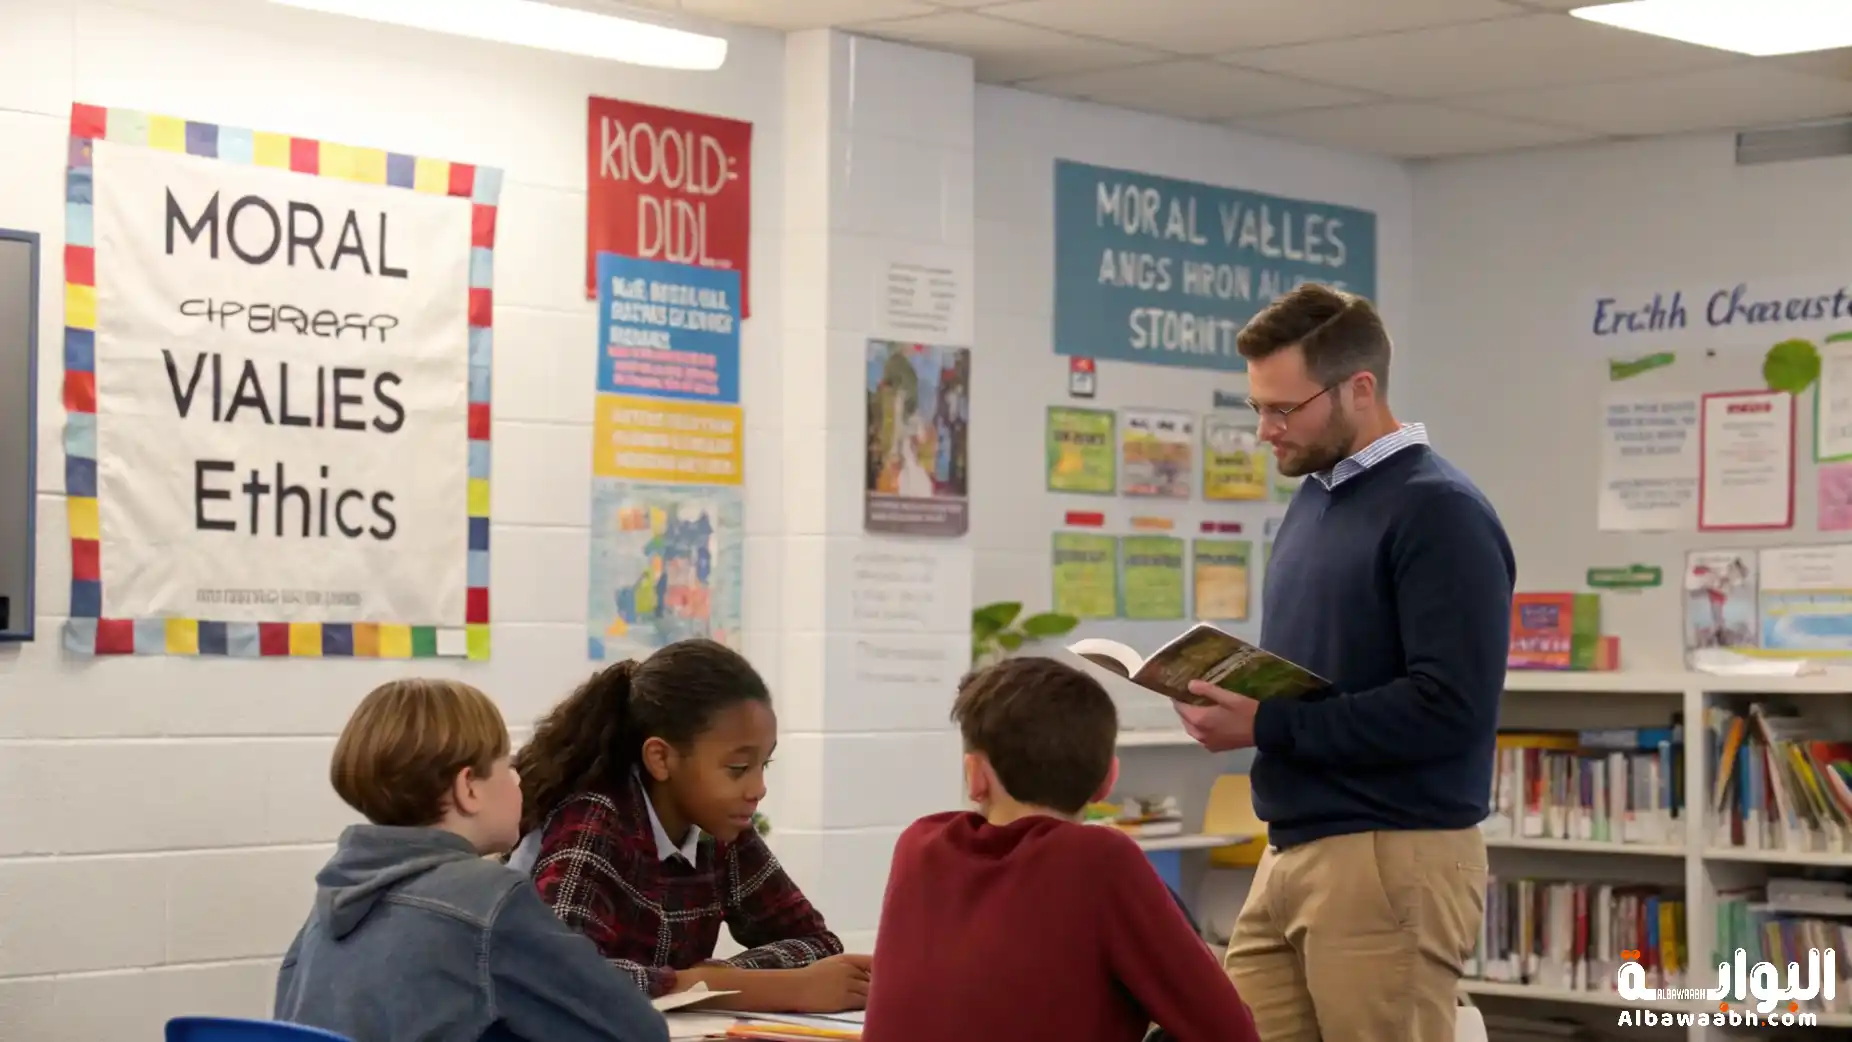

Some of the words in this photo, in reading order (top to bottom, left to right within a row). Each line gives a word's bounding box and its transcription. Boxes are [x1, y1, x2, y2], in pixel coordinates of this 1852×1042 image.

[165, 185, 408, 279] MORAL
[1096, 180, 1207, 246] MORAL
[1098, 248, 1173, 292] ANGS
[161, 348, 406, 434] VIALIES
[195, 459, 398, 541] Ethics
